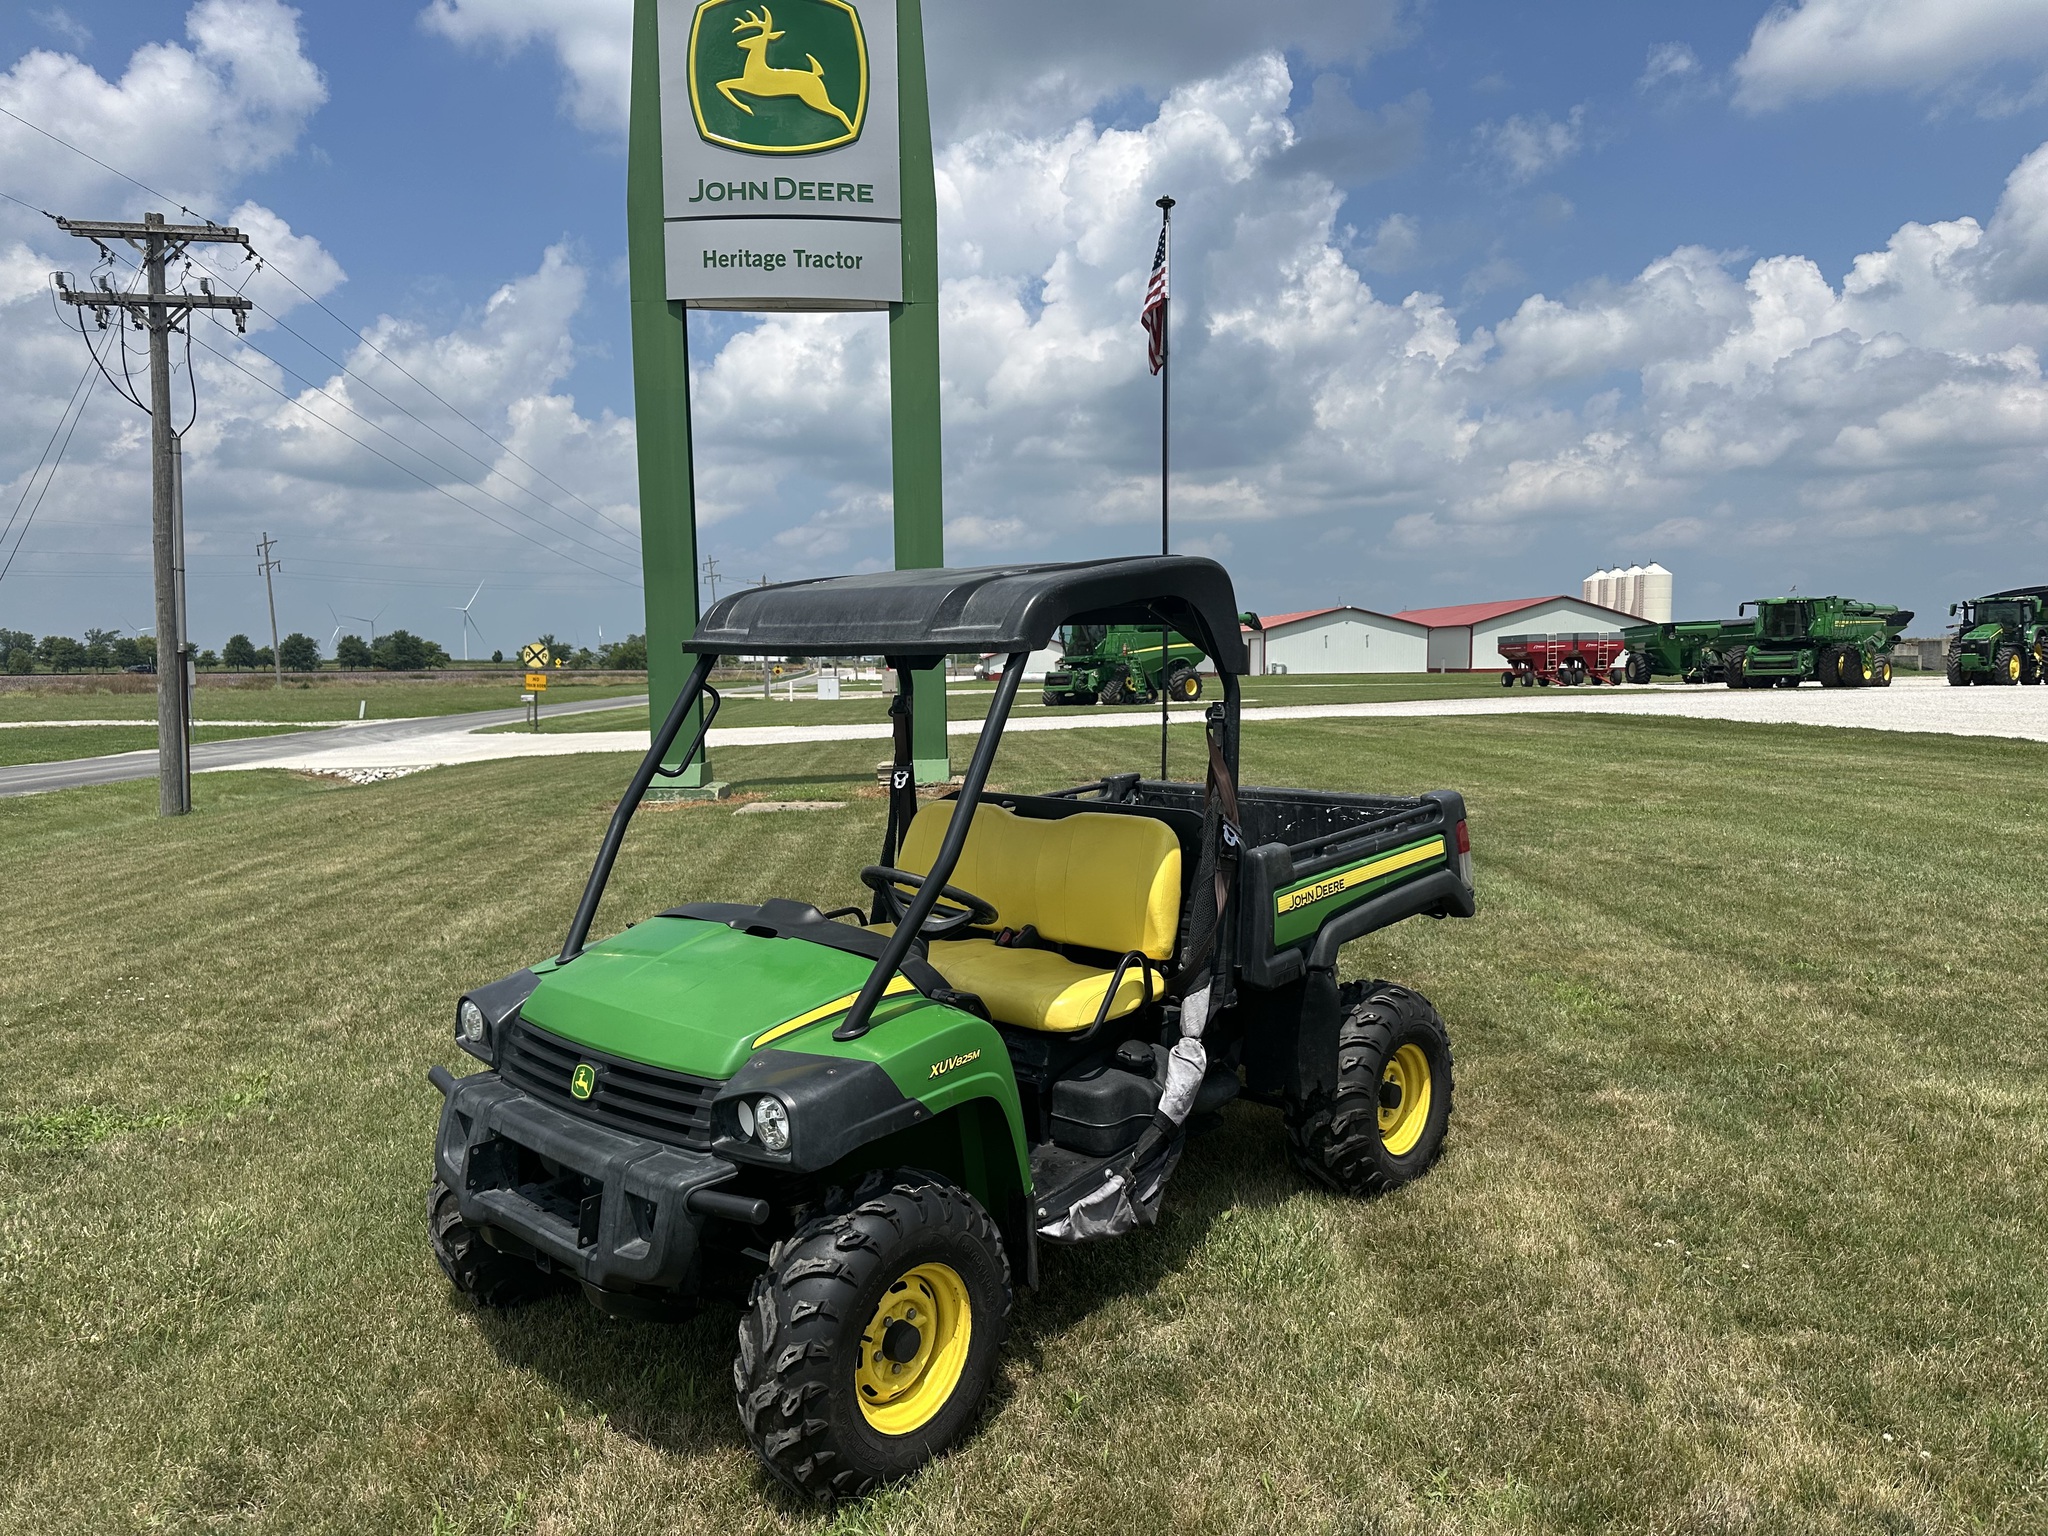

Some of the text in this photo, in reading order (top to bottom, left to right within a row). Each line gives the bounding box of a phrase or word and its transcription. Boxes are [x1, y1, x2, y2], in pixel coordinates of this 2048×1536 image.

[688, 177, 874, 204] JOHN DEERE
[703, 249, 863, 271] Heritage Tractor
[1289, 879, 1345, 909] JOHN DEERE
[928, 1048, 981, 1079] XUV825M
